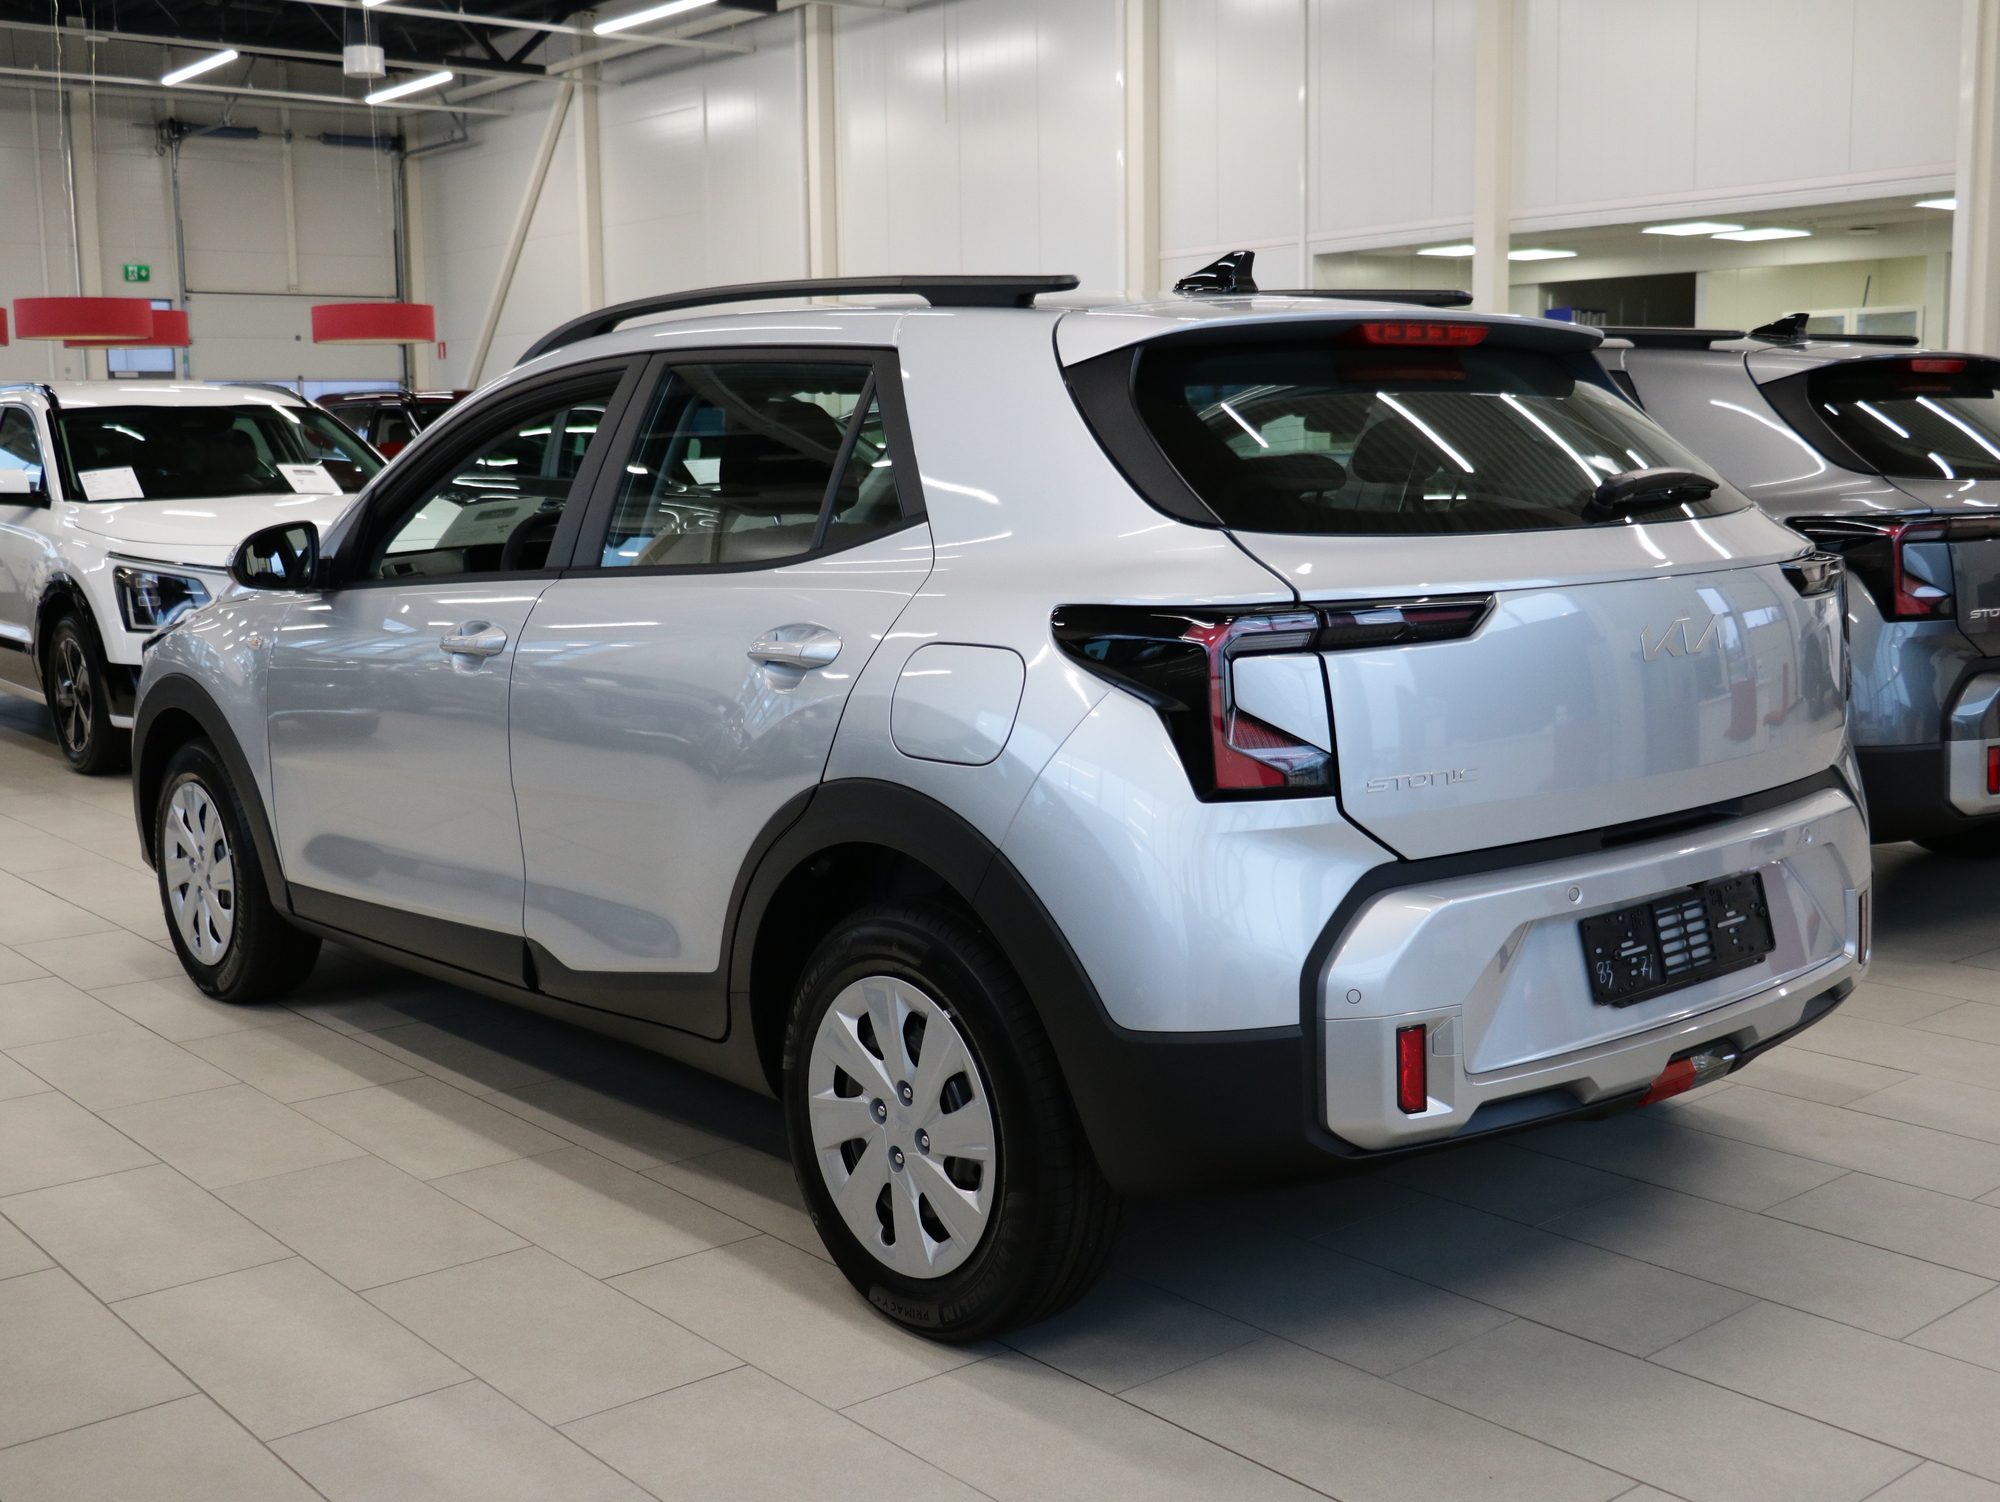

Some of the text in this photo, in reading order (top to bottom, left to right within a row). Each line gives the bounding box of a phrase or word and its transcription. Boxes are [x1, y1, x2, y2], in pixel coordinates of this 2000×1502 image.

[1639, 612, 1726, 662] KIA
[1366, 766, 1480, 793] STONIC
[942, 1244, 1012, 1323] MICHELIN
[883, 1298, 929, 1321] PRIMACY
